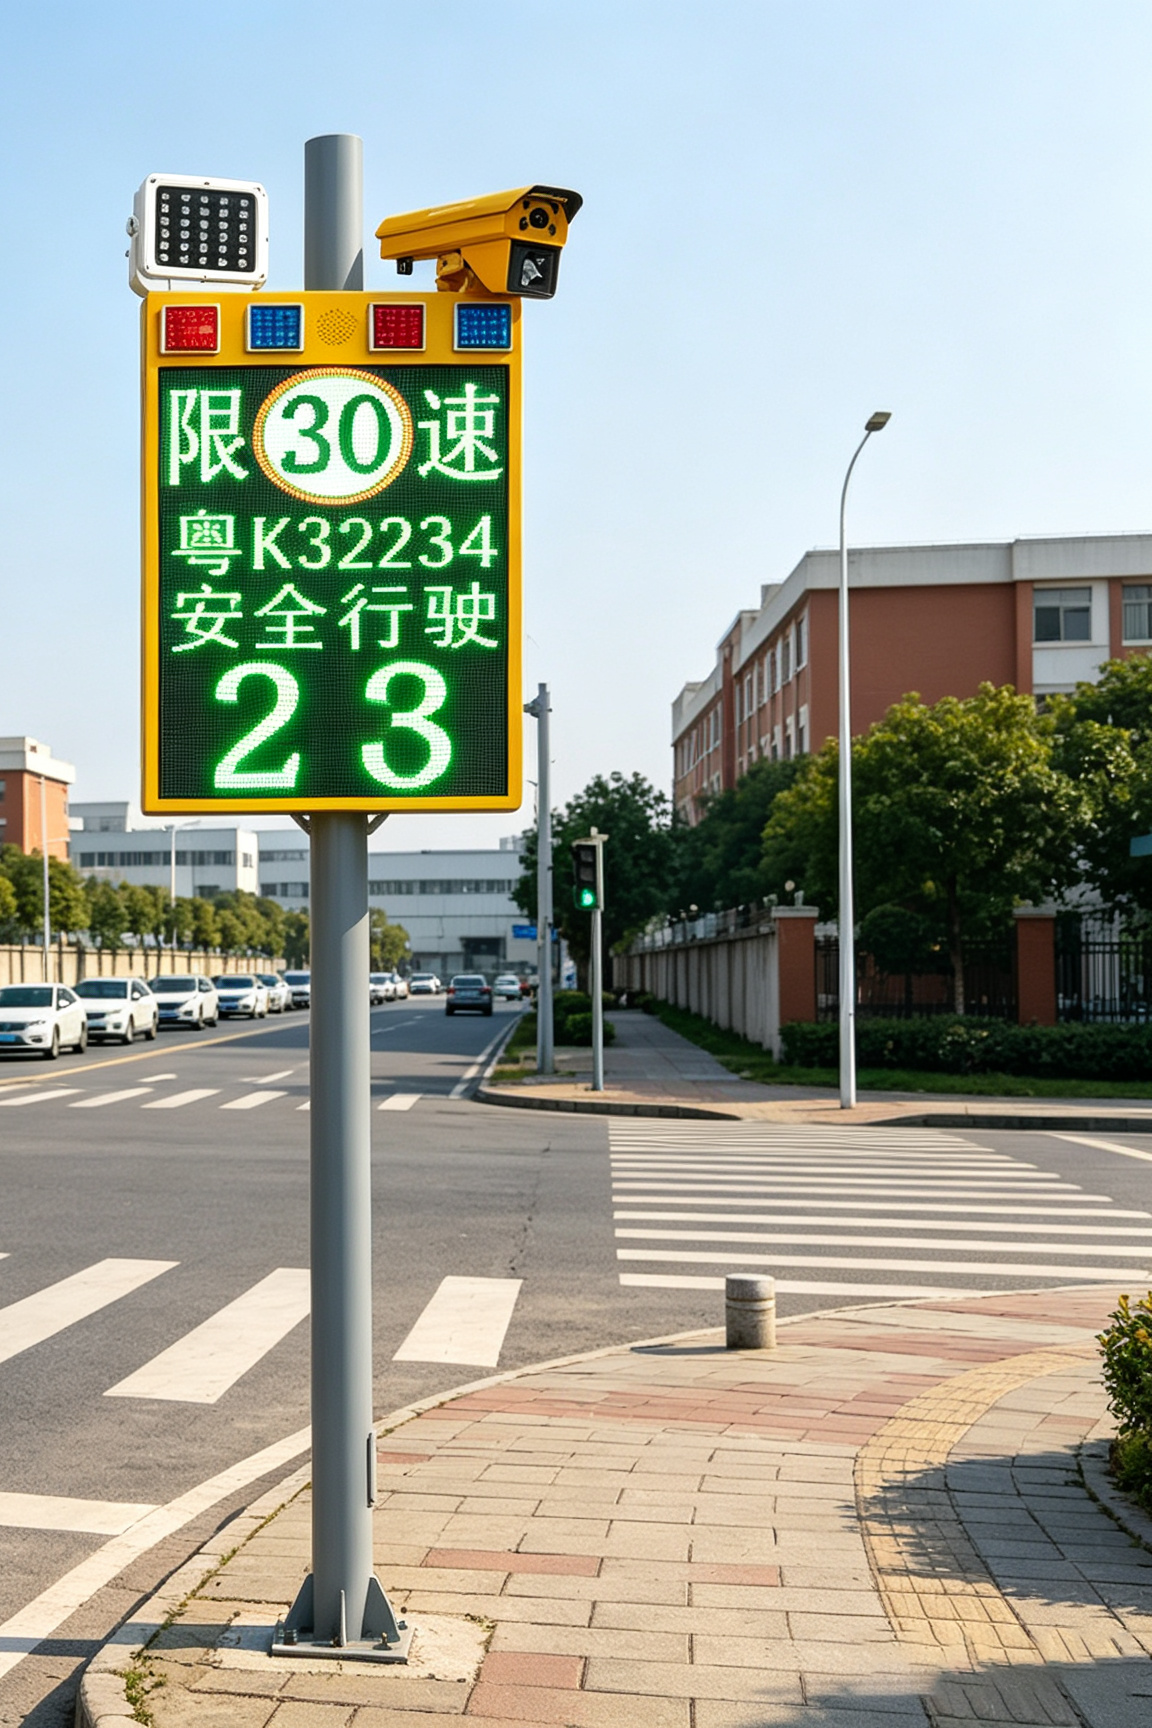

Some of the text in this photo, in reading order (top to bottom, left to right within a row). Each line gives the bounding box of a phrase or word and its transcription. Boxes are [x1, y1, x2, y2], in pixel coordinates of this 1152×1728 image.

[168, 383, 504, 486] 限 30 速
[171, 581, 499, 652] 安全行驶
